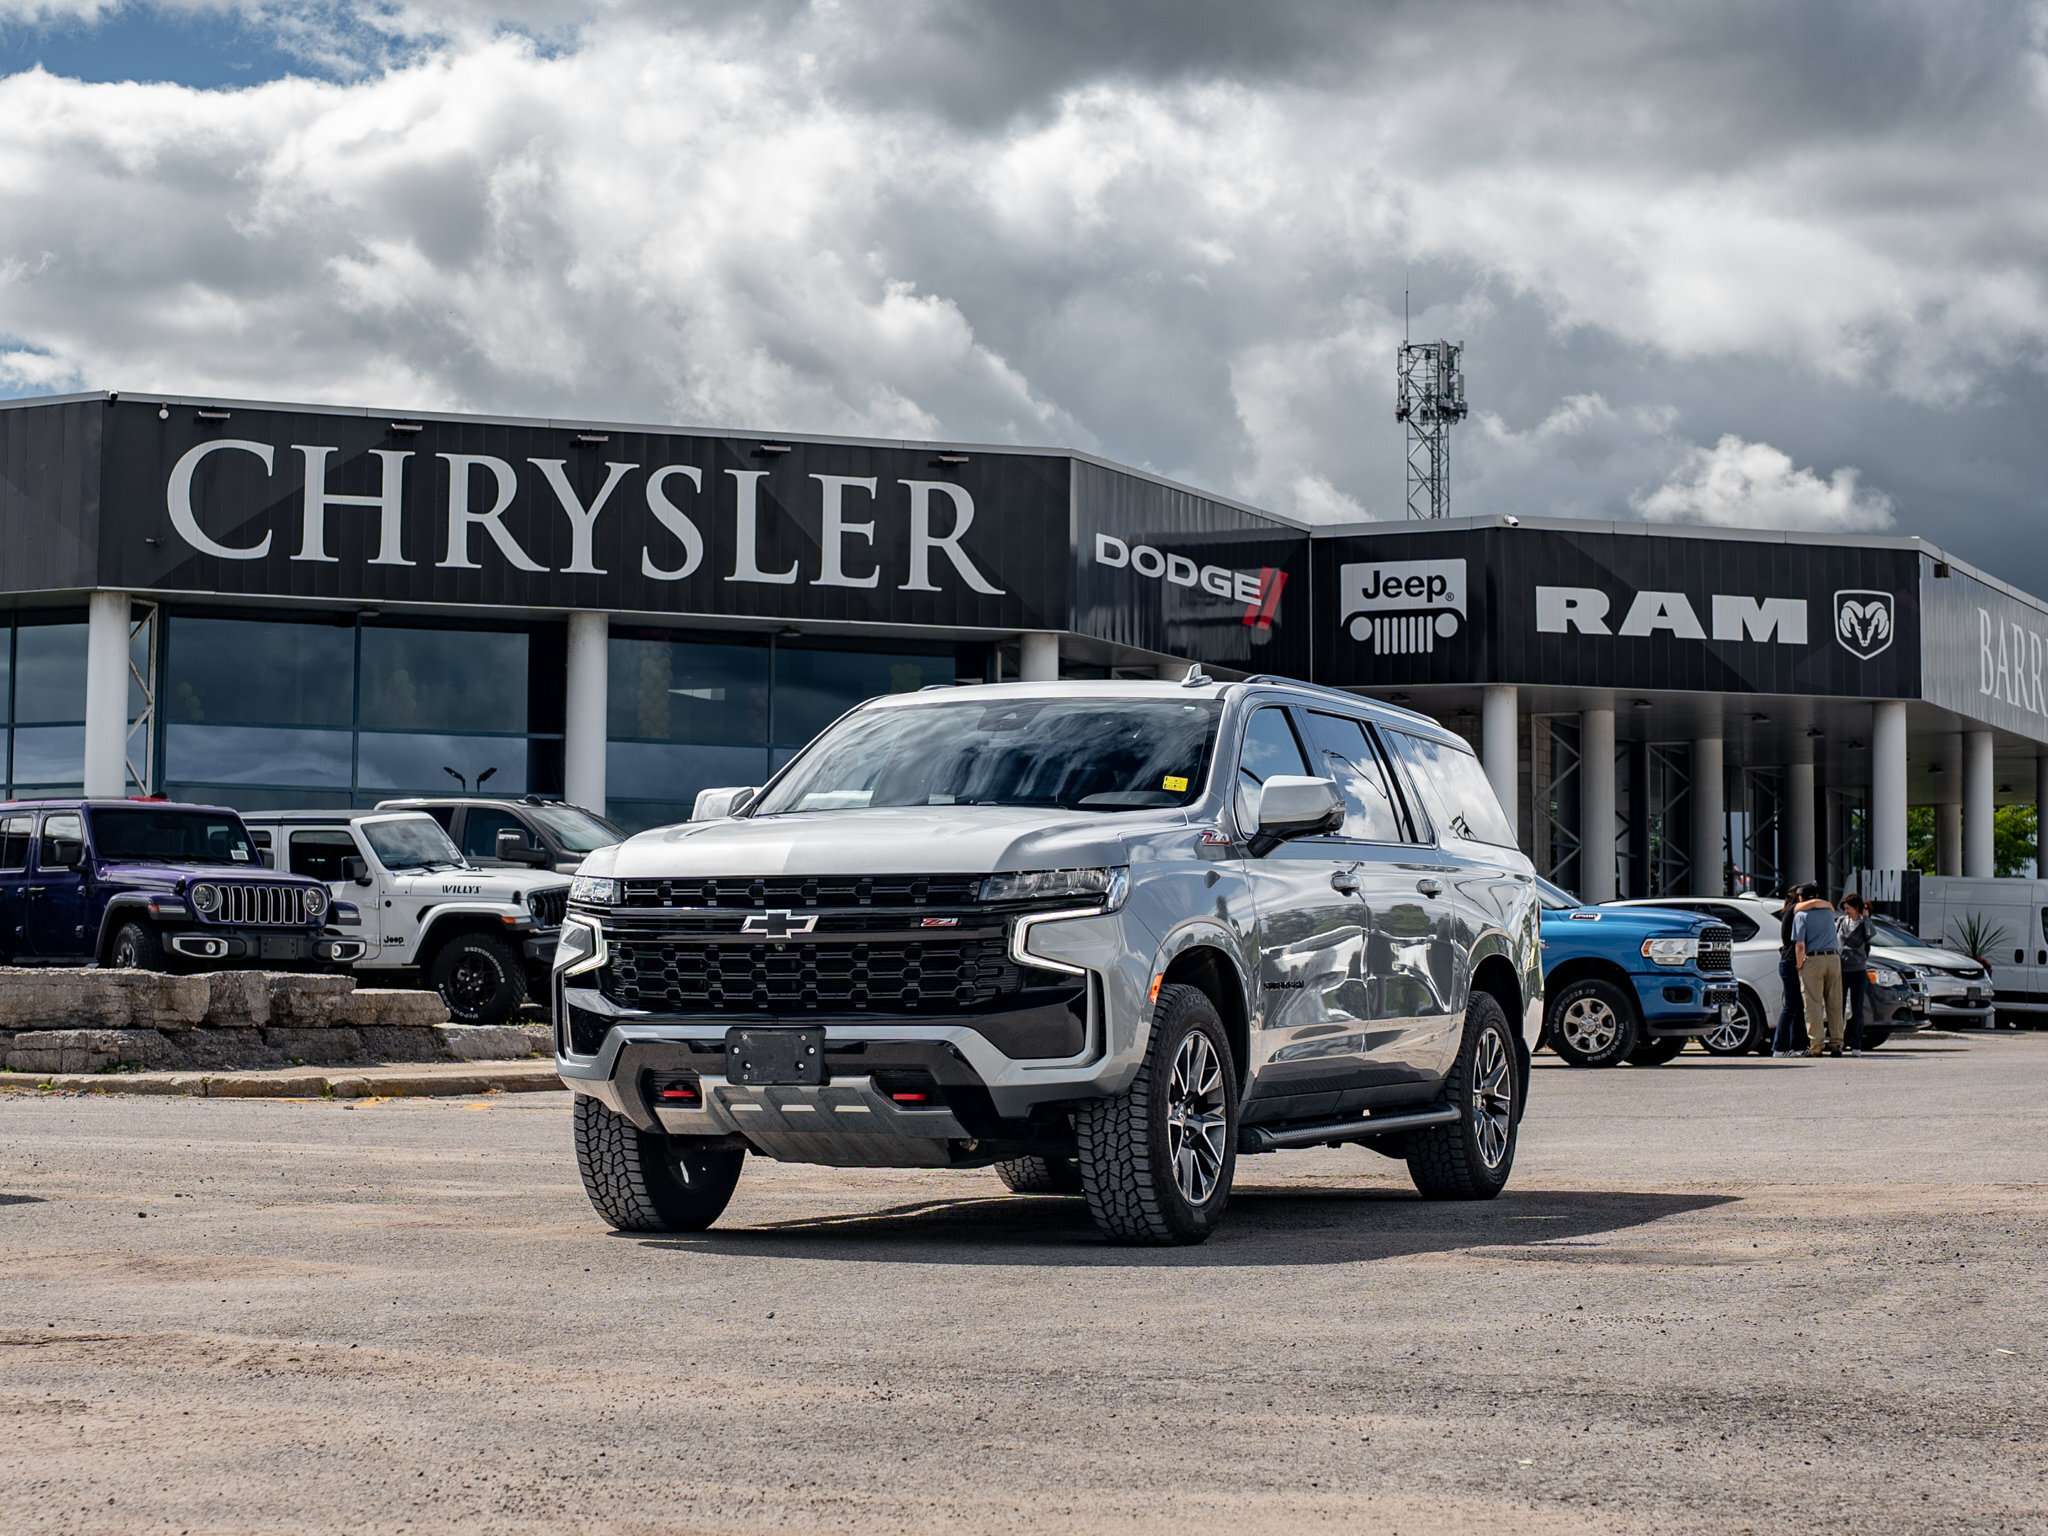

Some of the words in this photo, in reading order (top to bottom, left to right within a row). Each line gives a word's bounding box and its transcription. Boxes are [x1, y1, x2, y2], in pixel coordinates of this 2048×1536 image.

[166, 439, 1006, 595] CHRYSLER
[1095, 532, 1262, 607] DODGE
[1361, 570, 1447, 603] Jeep
[1535, 585, 1808, 645] RAM
[1977, 607, 2048, 719] BARR
[442, 885, 481, 894] WILLYS
[1861, 868, 1902, 902] RAM
[383, 935, 404, 944] Jeep
